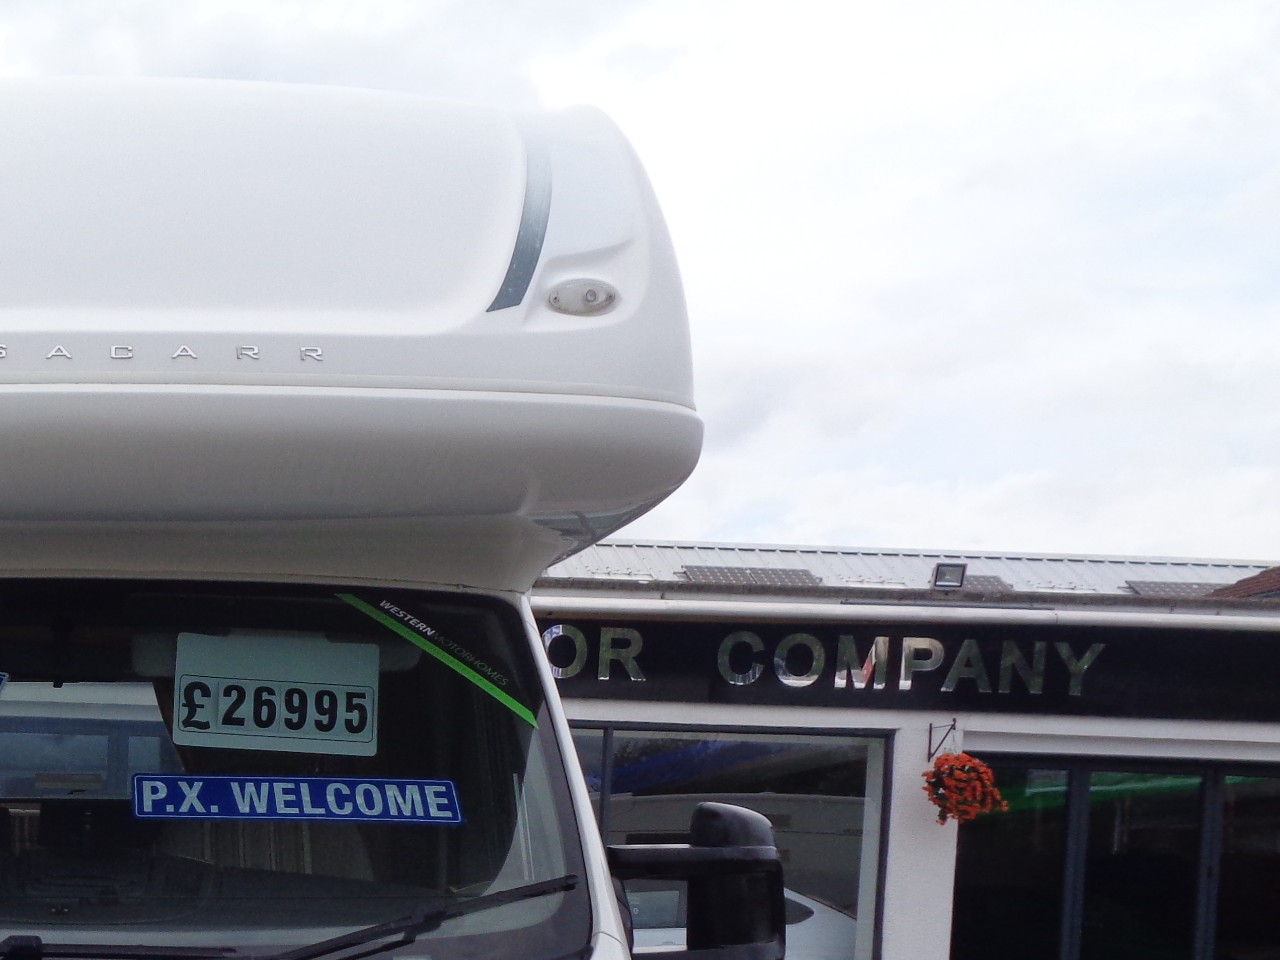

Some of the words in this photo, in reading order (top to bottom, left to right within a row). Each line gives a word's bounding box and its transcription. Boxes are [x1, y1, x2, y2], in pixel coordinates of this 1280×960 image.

[717, 630, 1106, 696] COMPANY
[142, 780, 219, 813] P.X.
[231, 781, 454, 819] WELCOME
